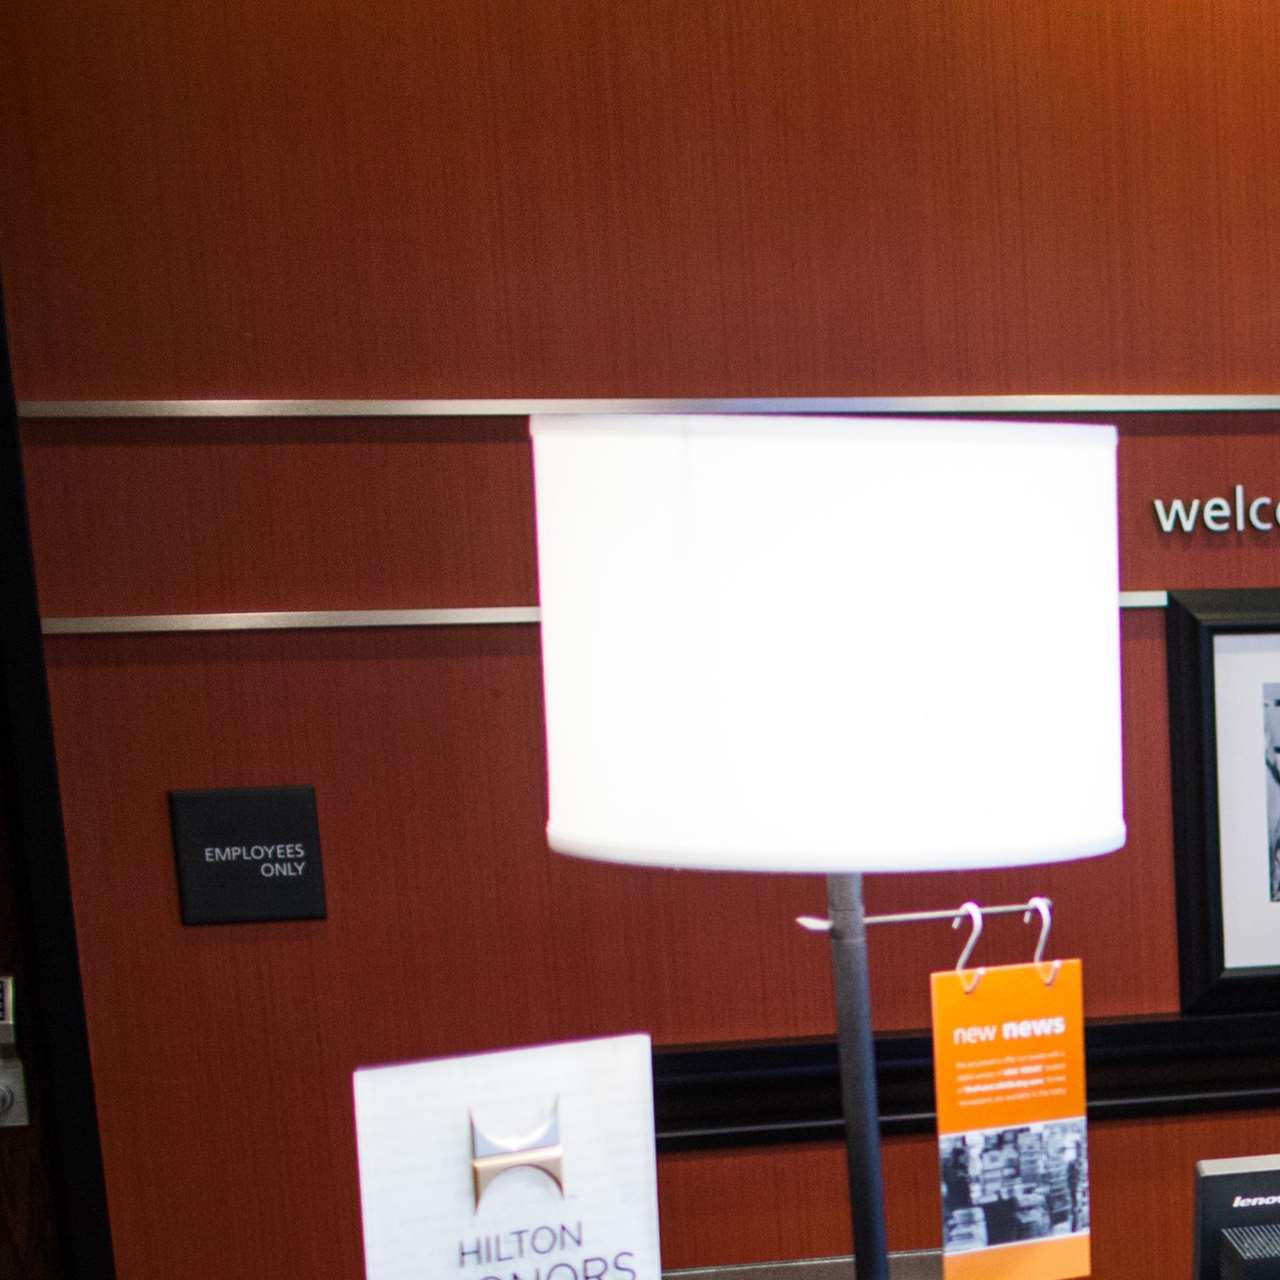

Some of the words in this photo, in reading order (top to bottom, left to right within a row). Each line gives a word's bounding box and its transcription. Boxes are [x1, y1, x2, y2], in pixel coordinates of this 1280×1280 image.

[204, 843, 305, 862] EMPLOYEES
[260, 862, 305, 877] ONLY
[953, 1024, 998, 1046] new
[1002, 1016, 1066, 1040] news
[457, 1221, 584, 1269] HILTON
